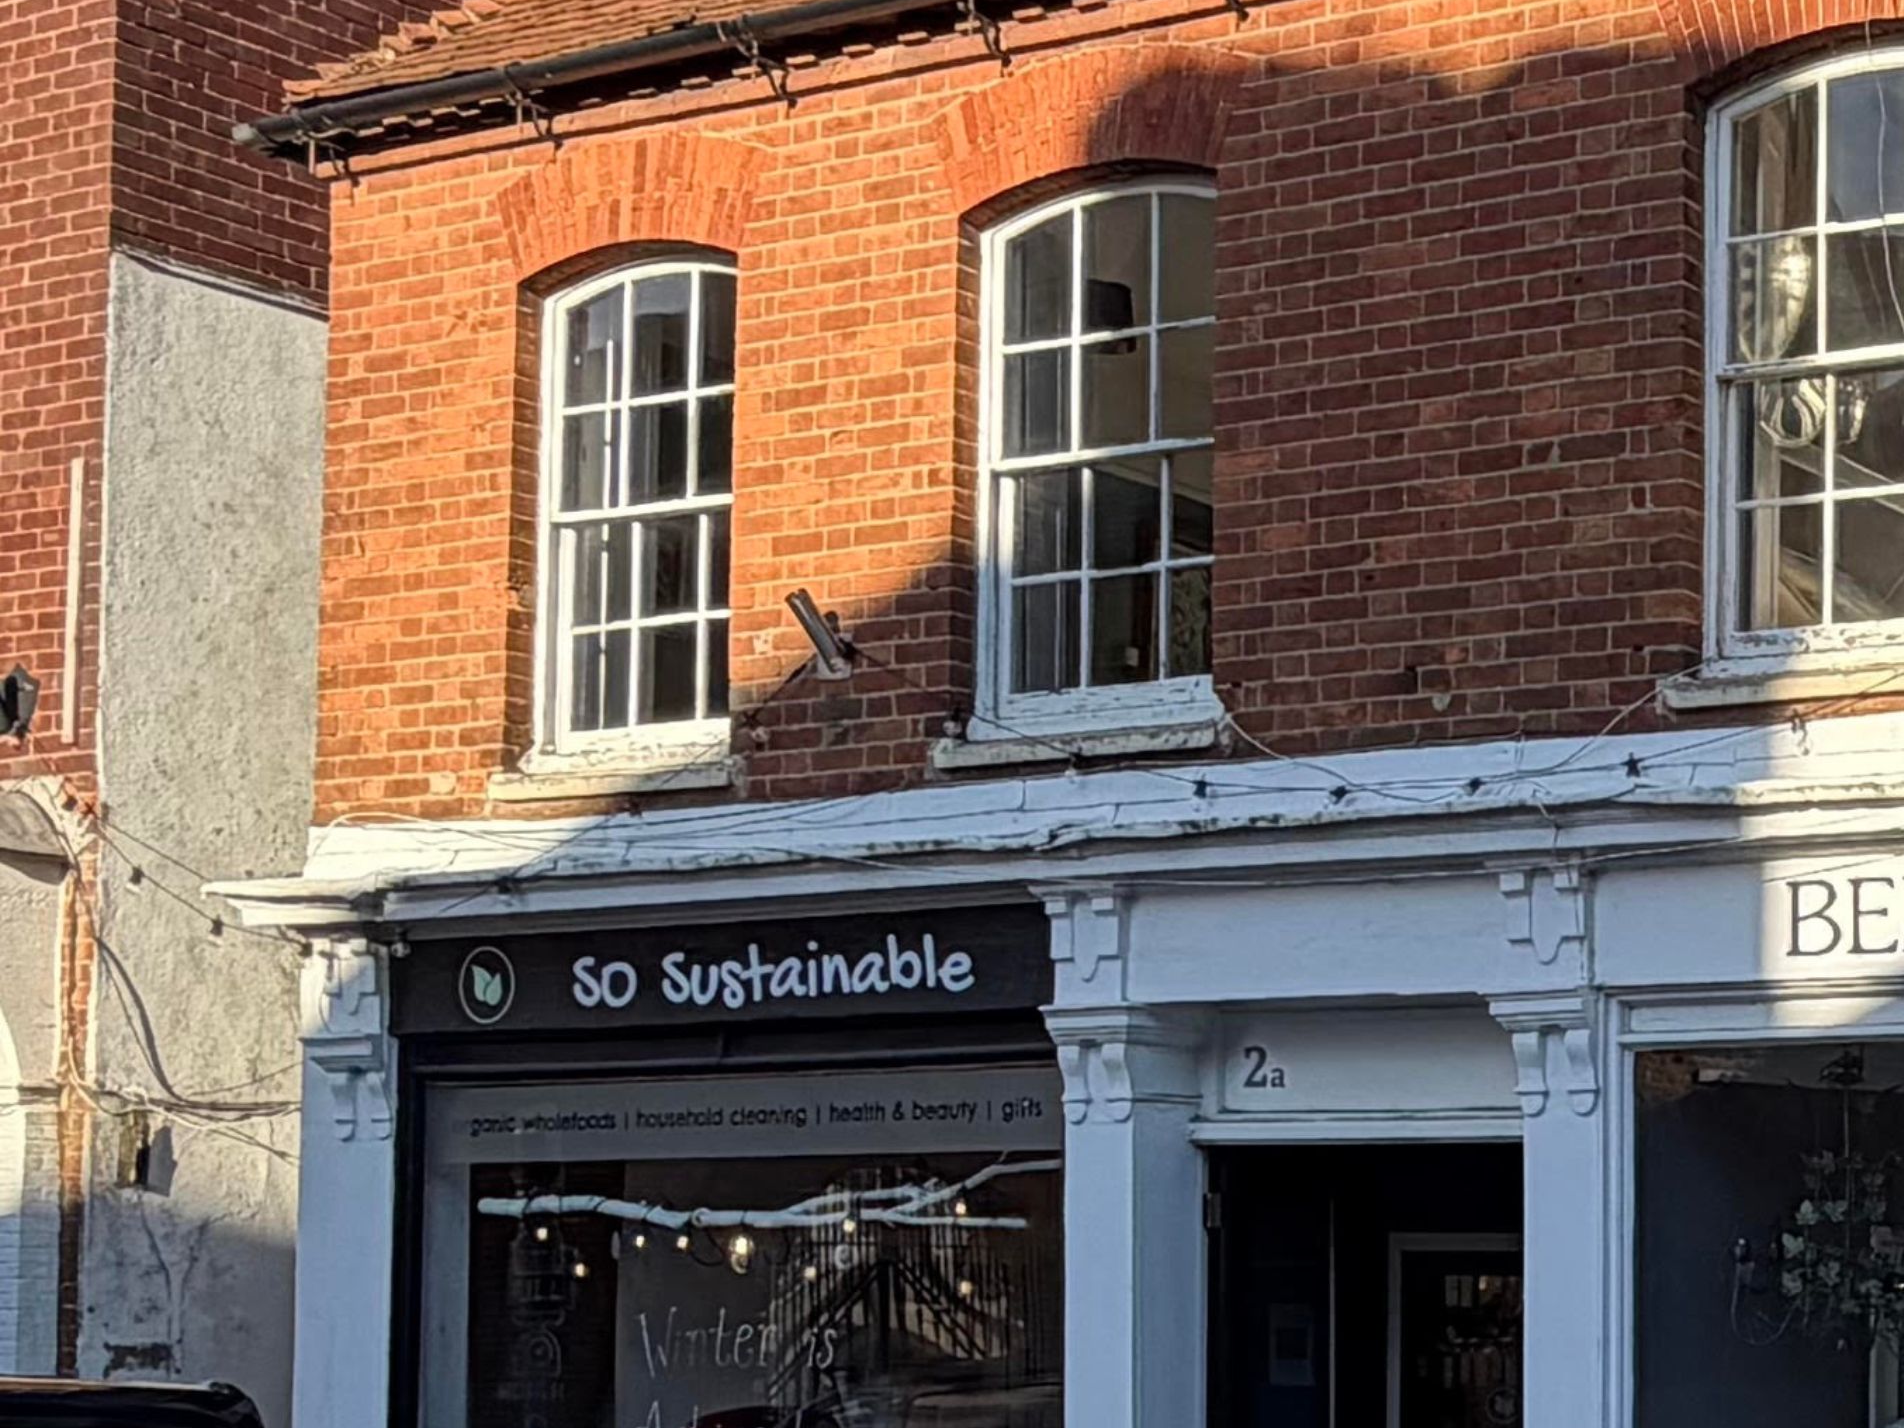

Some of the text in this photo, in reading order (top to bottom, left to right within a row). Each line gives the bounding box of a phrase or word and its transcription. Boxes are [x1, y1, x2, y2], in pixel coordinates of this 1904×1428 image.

[661, 933, 975, 1009] Sustainable
[1243, 1045, 1286, 1089] 2a
[467, 1096, 1043, 1138] ganic wholefoods household cleaning health & beauty gifts
[637, 1306, 837, 1379] Winter is
